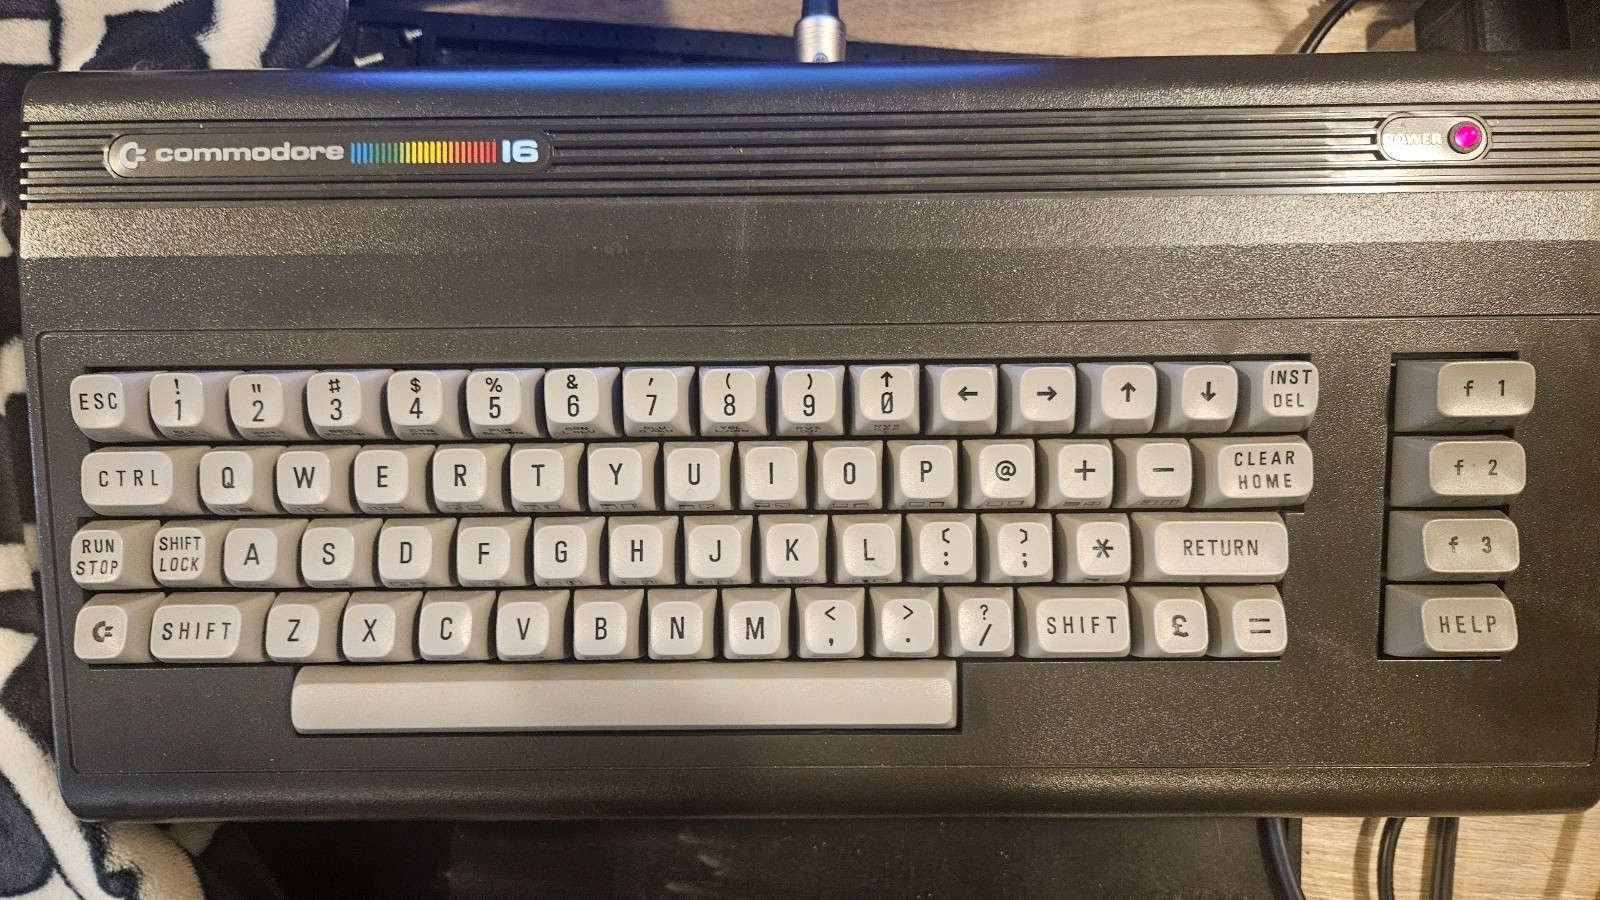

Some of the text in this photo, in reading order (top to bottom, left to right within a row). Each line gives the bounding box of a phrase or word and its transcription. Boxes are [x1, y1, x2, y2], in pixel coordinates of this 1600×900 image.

[155, 139, 539, 163] commodore 16
[328, 378, 341, 394] #
[410, 377, 421, 394] $
[485, 377, 503, 392] %
[566, 374, 578, 390] &
[726, 373, 731, 390] (
[807, 373, 813, 390] )
[1270, 369, 1312, 385] INST
[1463, 379, 1505, 397] f 1
[79, 392, 117, 410] ESC
[174, 399, 182, 421] 1
[252, 400, 264, 422] 2
[330, 398, 342, 421] 3
[409, 397, 423, 419] 4
[489, 396, 501, 419] 5
[567, 394, 580, 417] 6
[646, 394, 657, 416] 7
[724, 394, 736, 416] 8
[803, 394, 815, 417] 9
[1274, 393, 1304, 408] DEL
[1234, 450, 1294, 466] CLEAR
[1454, 459, 1498, 476] f 2
[98, 469, 158, 487] CTRL
[222, 466, 235, 489] Q
[292, 466, 316, 489] W
[377, 465, 388, 488] E
[454, 464, 467, 487] R
[531, 464, 545, 487] T
[608, 462, 623, 486] Y
[688, 463, 700, 486] U
[769, 462, 774, 484] I
[920, 460, 933, 482] P
[995, 460, 1017, 482] @
[1074, 460, 1096, 481] +
[1238, 473, 1292, 490] HOME
[82, 539, 114, 554] RUN
[159, 536, 201, 551] SHIFT
[243, 542, 260, 566] A
[322, 542, 335, 566] S
[400, 541, 412, 564] D
[478, 542, 490, 564] F
[555, 540, 568, 563] G
[631, 539, 644, 562] H
[709, 540, 721, 562] J
[786, 538, 799, 561] K
[863, 538, 875, 561] L
[1183, 539, 1258, 556] RETURN
[1448, 536, 1492, 554] f 3
[76, 560, 118, 576] STOP
[160, 557, 199, 572] LOCK
[943, 551, 949, 566] :
[824, 606, 836, 621] <
[902, 605, 914, 620] >
[980, 604, 988, 620] ?
[162, 622, 232, 641] SHIFT
[287, 619, 300, 642] Z
[362, 618, 377, 642] X
[440, 616, 453, 640] C
[516, 618, 530, 640] V
[595, 617, 607, 640] B
[670, 616, 684, 640] N
[746, 616, 764, 640] M
[978, 624, 992, 646] /
[1046, 616, 1117, 635] SHIFT
[1172, 614, 1189, 638] £
[1249, 618, 1271, 634] =
[1439, 615, 1496, 634] HELP
